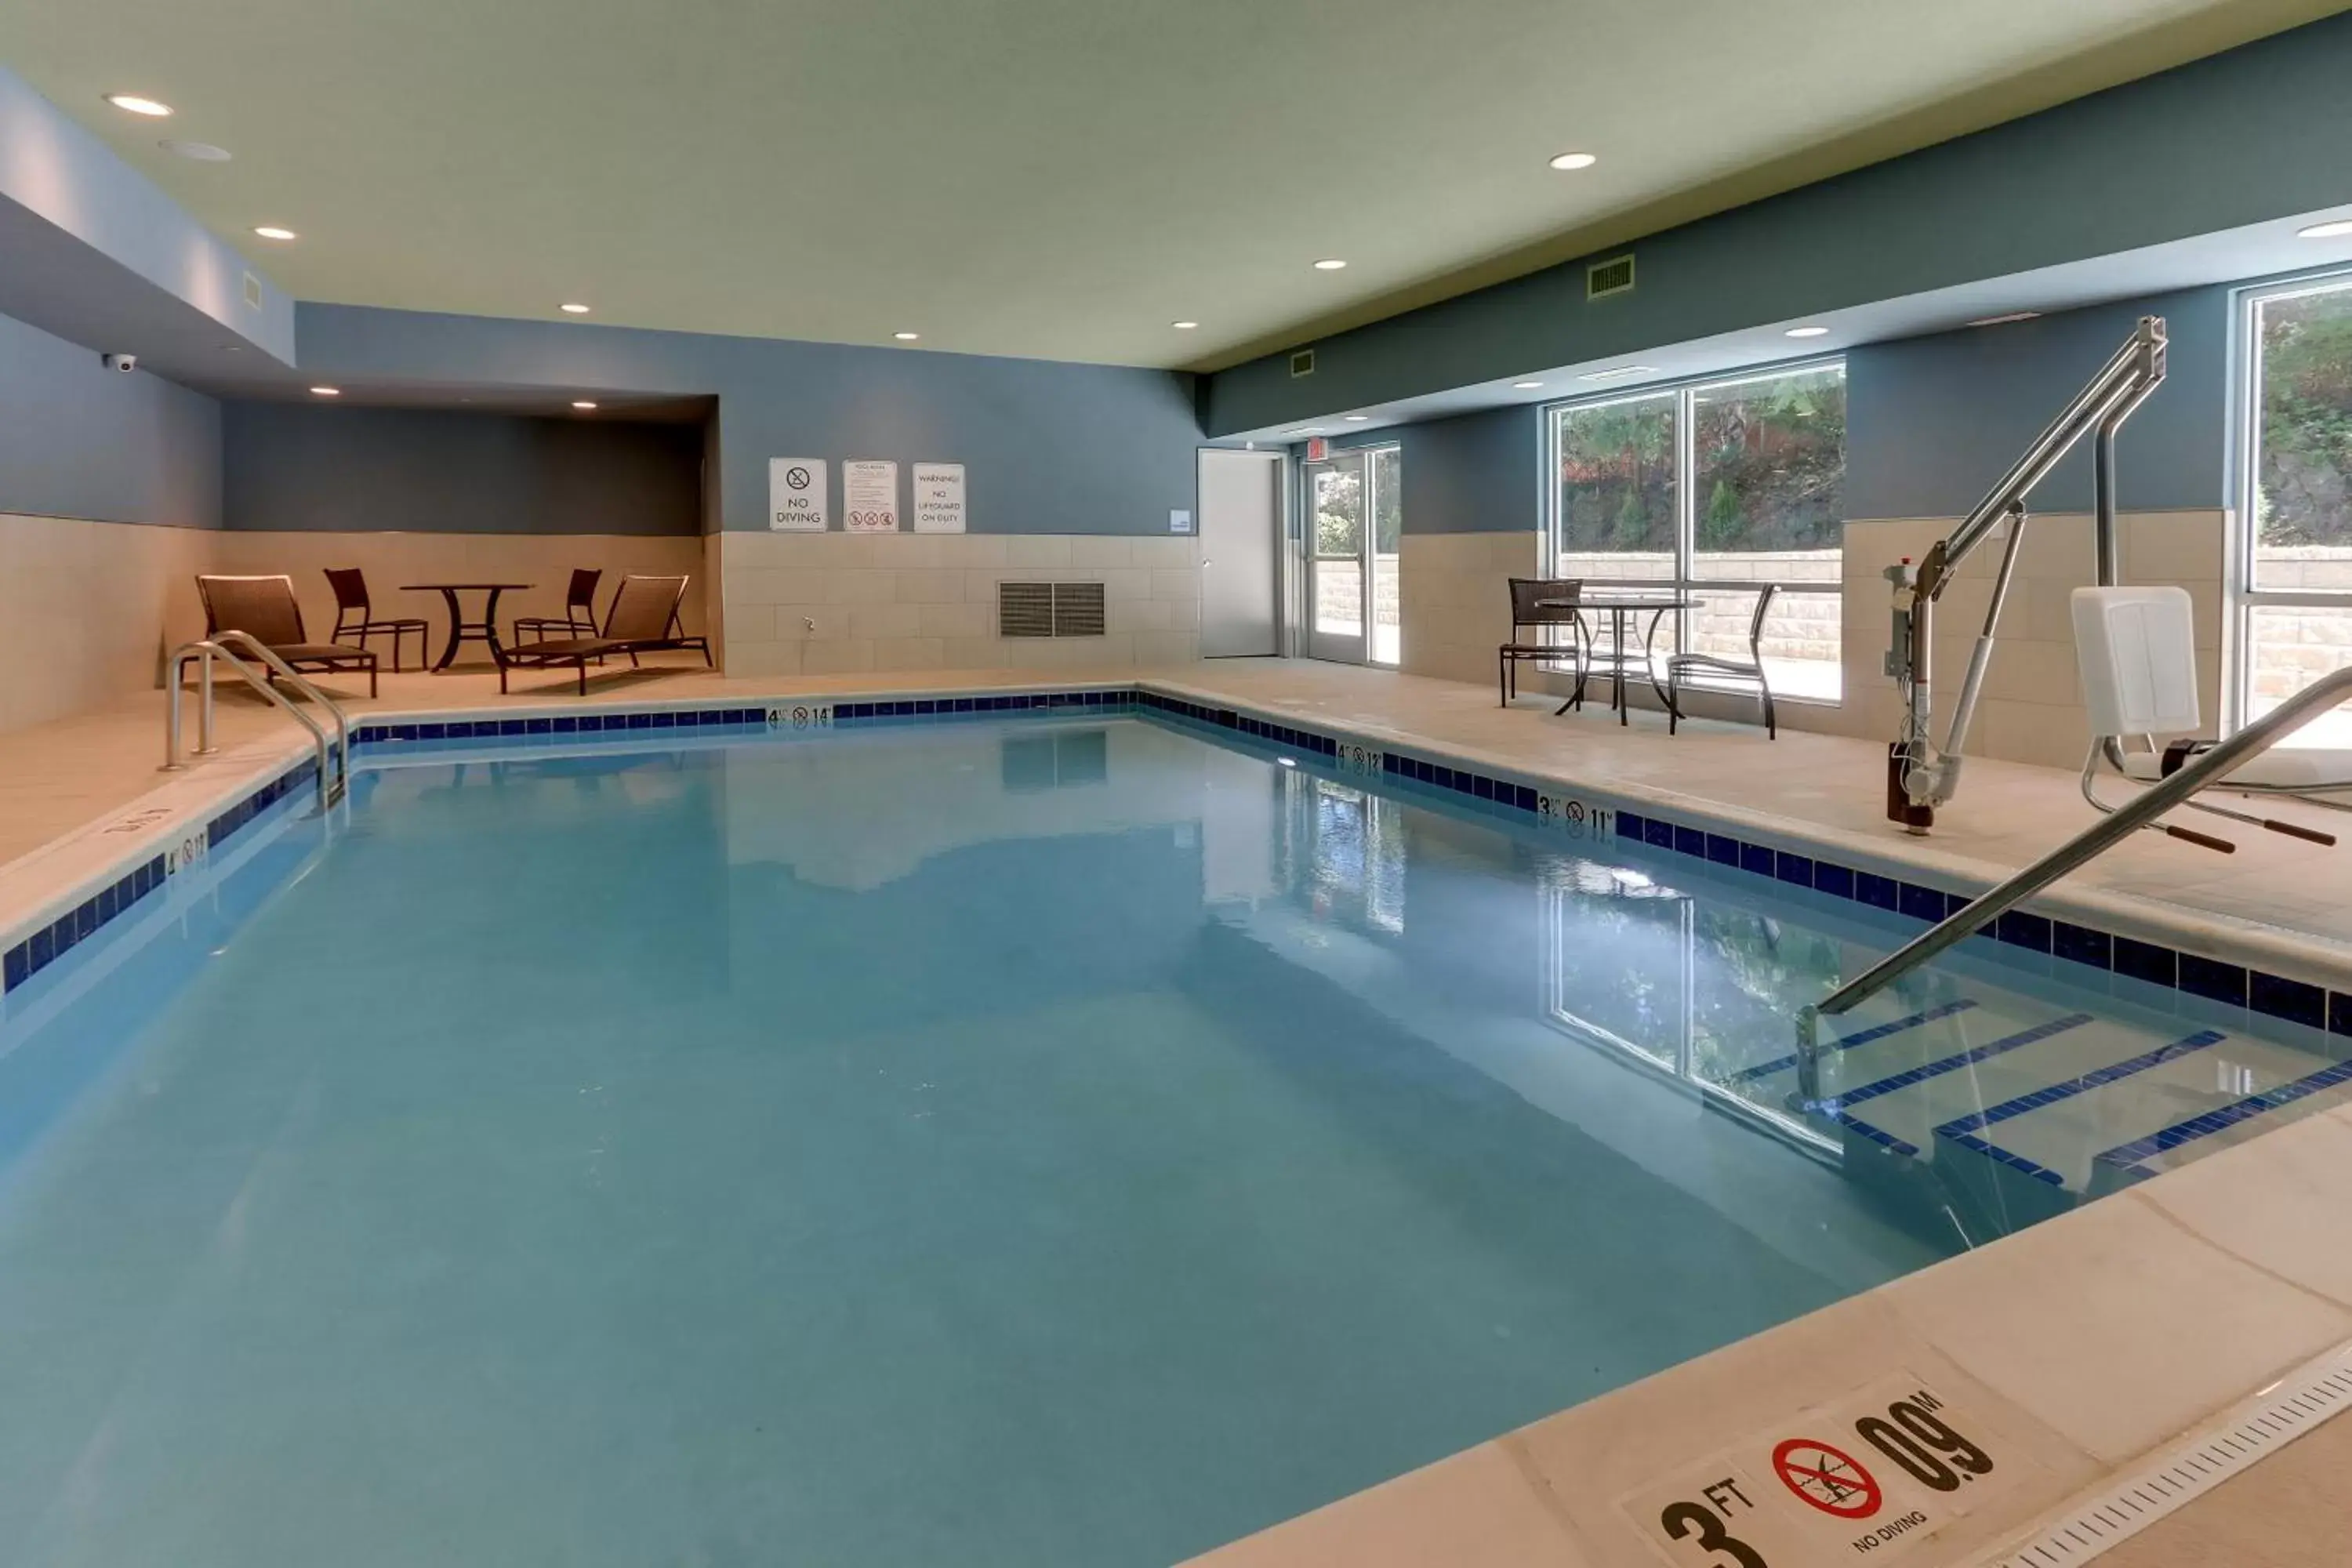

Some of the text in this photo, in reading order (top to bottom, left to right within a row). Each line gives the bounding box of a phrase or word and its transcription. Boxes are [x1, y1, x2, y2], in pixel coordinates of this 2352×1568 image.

[788, 498, 808, 508] NO
[776, 512, 821, 523] DIVING
[1908, 1390, 1944, 1413] M
[1661, 1477, 1769, 1568] 3 FT
[1852, 1510, 1928, 1553] NO DIVING
